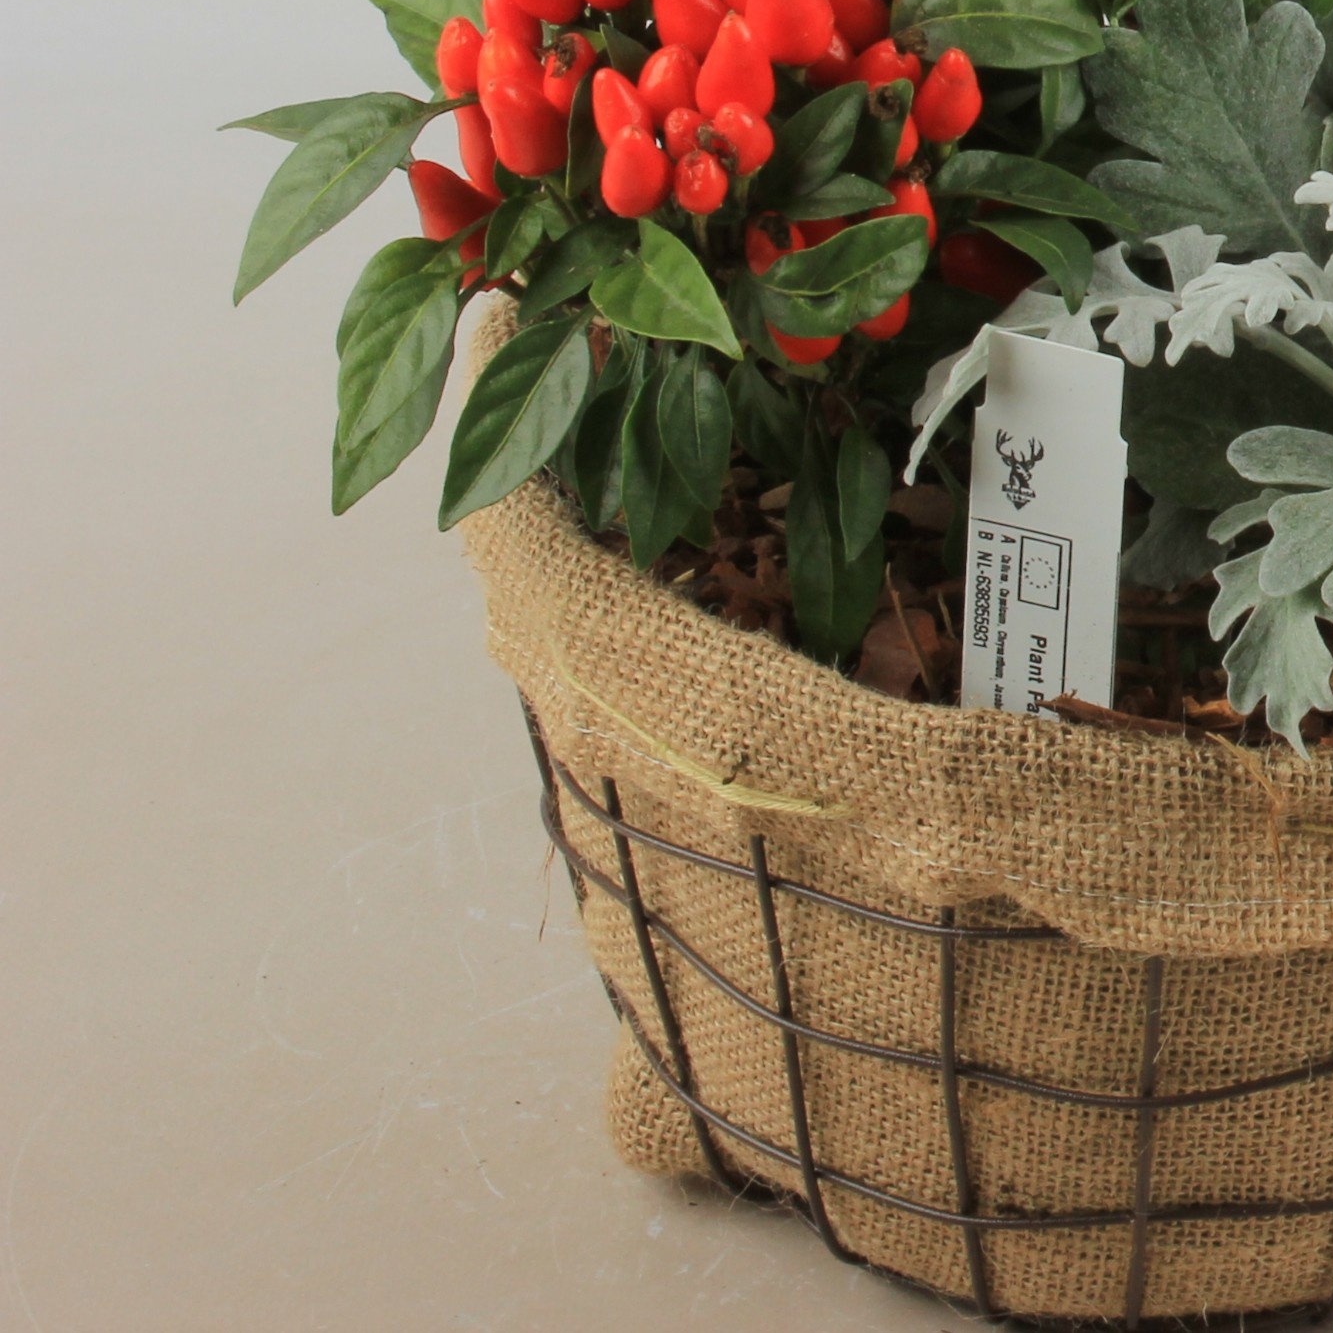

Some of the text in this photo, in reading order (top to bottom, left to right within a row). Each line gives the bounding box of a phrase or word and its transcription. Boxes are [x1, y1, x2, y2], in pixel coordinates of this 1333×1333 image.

[1001, 534, 1017, 544] A
[973, 529, 994, 649] B NL-638355931
[1028, 634, 1048, 684] Plant
